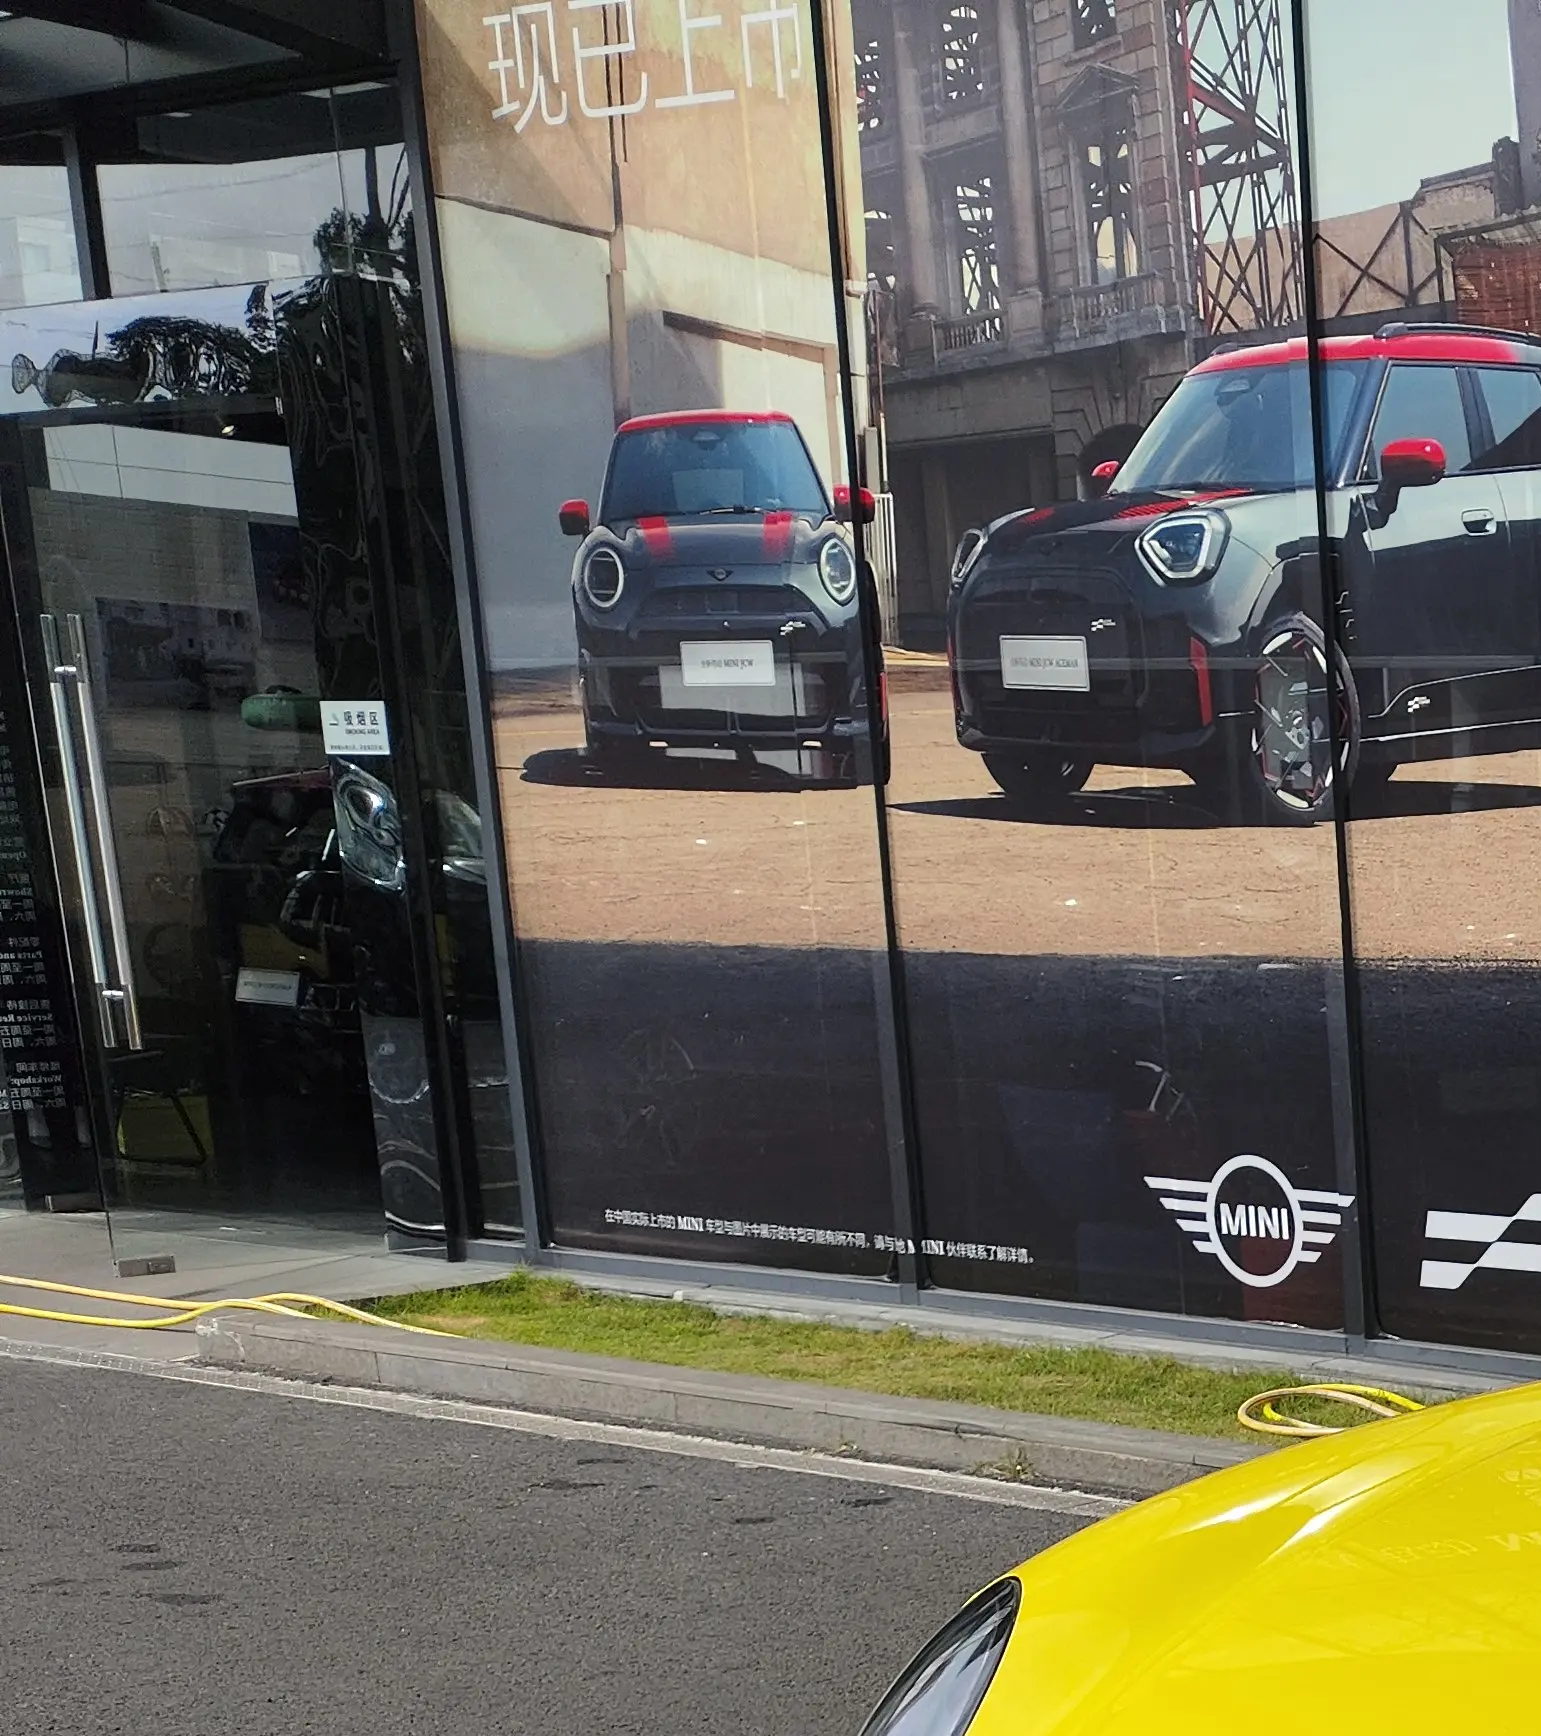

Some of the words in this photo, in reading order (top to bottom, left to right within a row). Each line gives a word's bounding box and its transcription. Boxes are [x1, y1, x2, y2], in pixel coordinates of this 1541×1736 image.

[482, 0, 802, 134] 现已上市
[343, 710, 379, 727] 吸烟区
[677, 1215, 705, 1233] MINI
[1219, 1203, 1290, 1242] MINI
